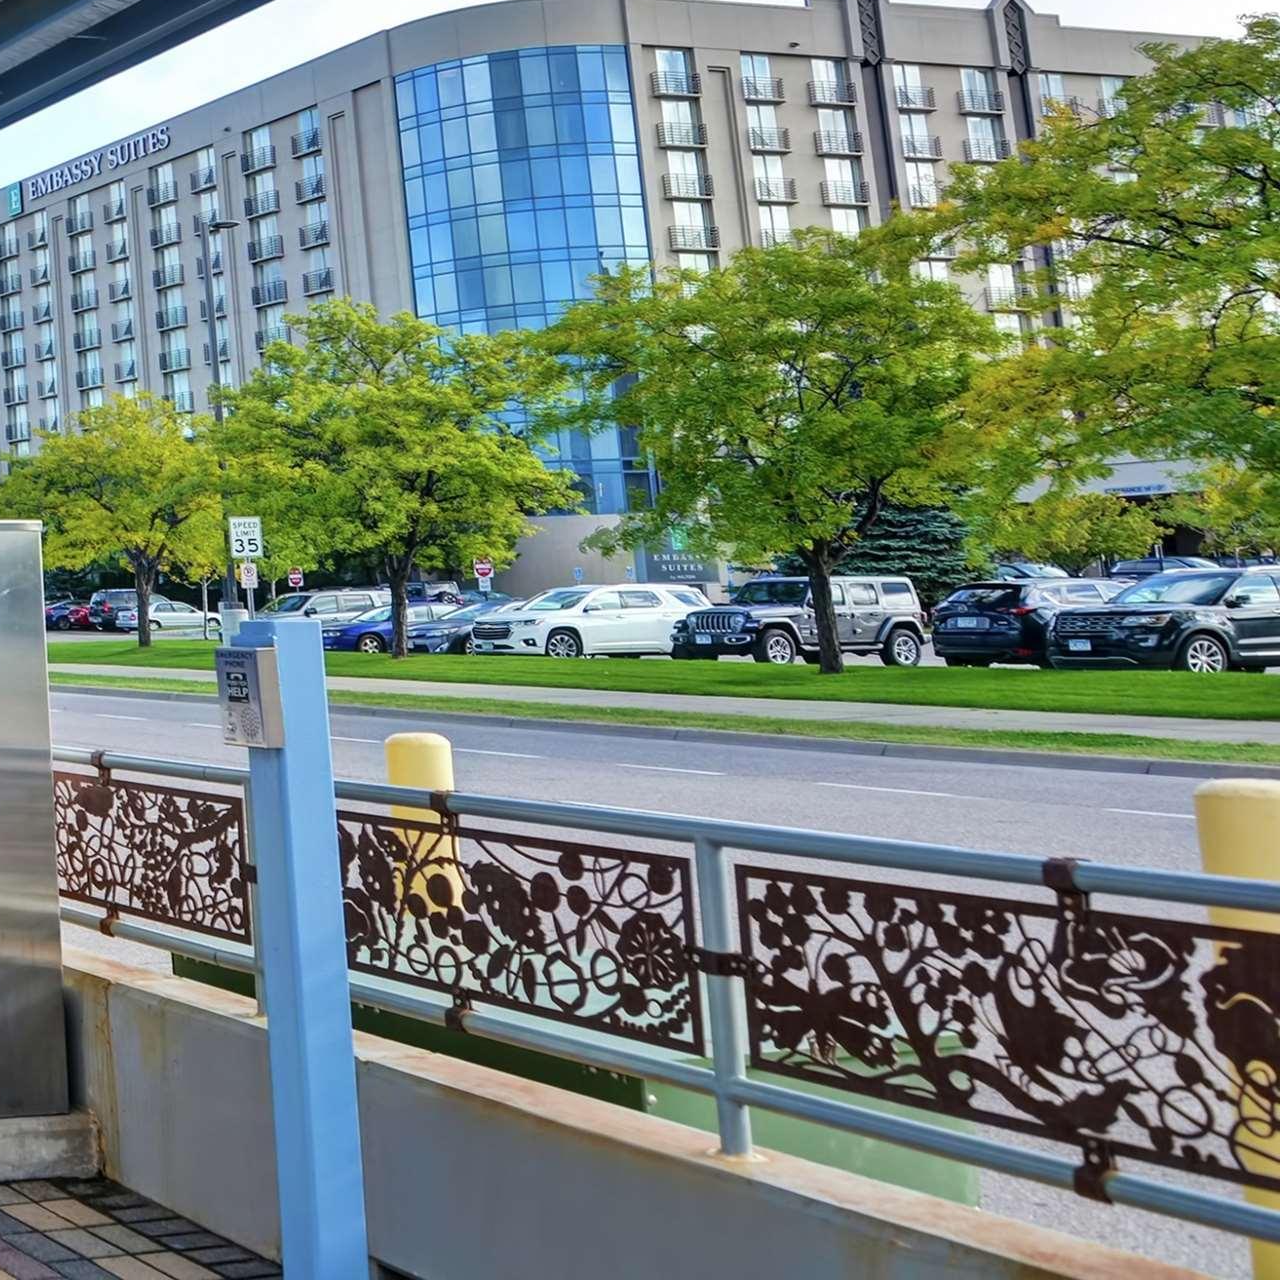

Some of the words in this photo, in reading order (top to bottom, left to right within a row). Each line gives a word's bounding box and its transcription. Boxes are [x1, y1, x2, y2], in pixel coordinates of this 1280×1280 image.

[28, 152, 104, 201] EMBASSY
[107, 126, 171, 168] SUITES
[232, 521, 258, 529] SPEED
[234, 538, 260, 553] 35
[661, 564, 704, 572] SUITES
[227, 686, 249, 698] HELP
